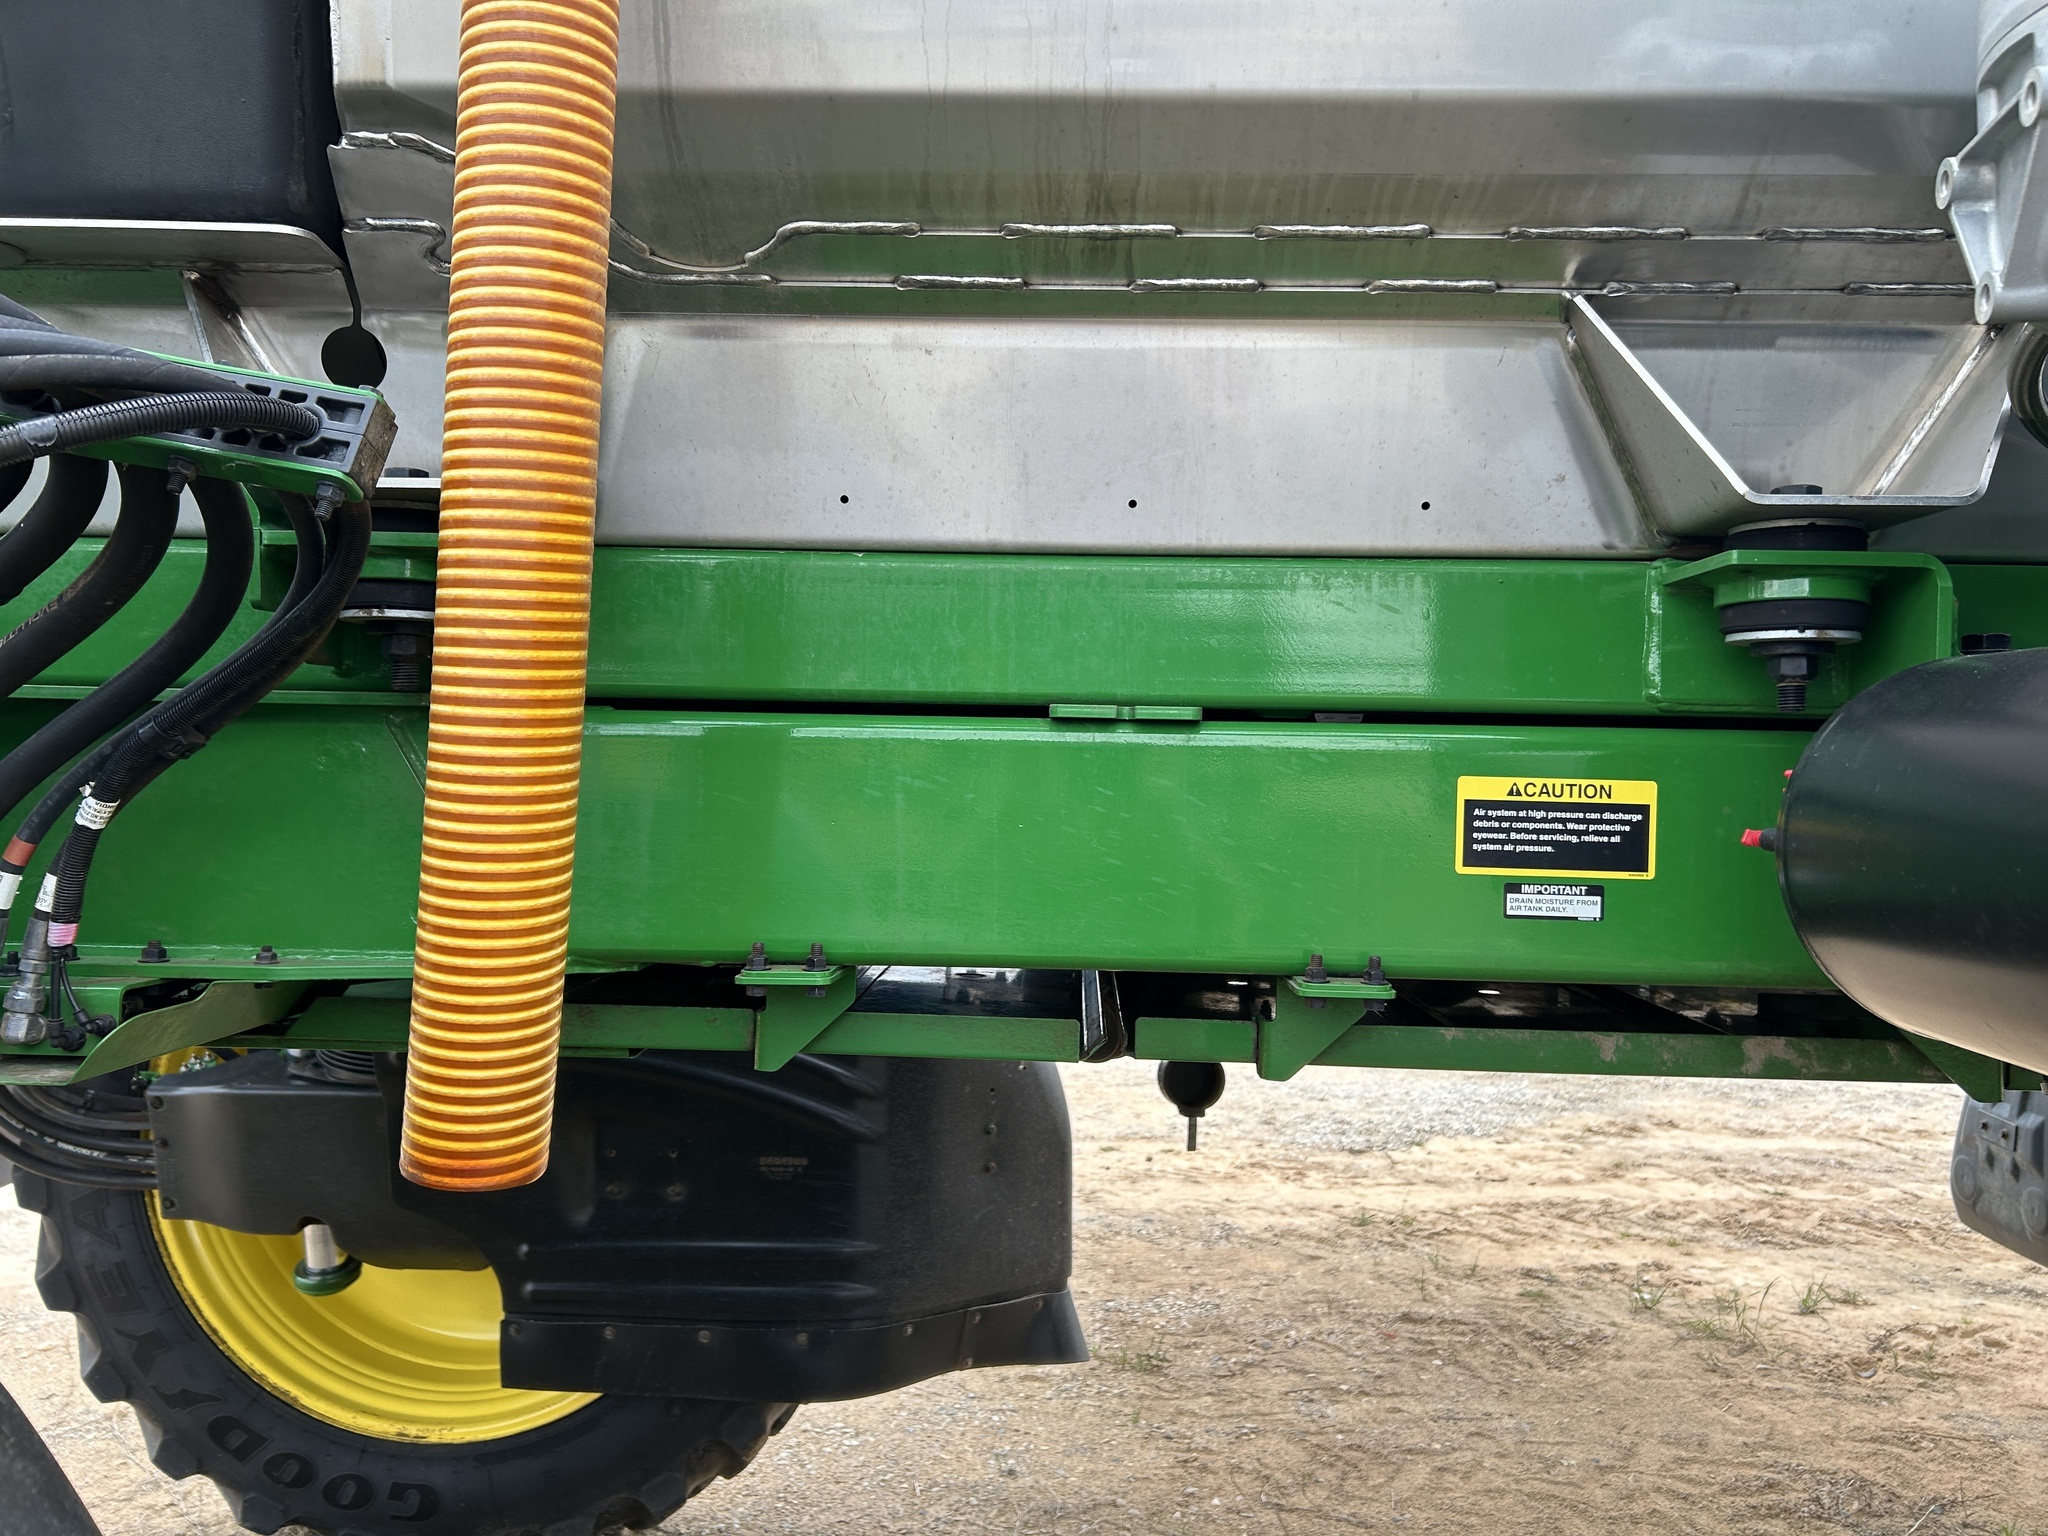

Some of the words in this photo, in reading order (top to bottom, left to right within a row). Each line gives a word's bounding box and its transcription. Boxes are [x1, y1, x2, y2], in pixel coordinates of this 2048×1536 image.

[1523, 782, 1612, 799] CAUTION
[1473, 808, 1486, 816] Air
[1487, 809, 1517, 818] system
[1528, 810, 1546, 819] high
[1547, 811, 1584, 820] pressure
[1602, 812, 1643, 822] discharge
[1473, 820, 1500, 828] debris
[1512, 821, 1565, 830] components.
[1566, 822, 1587, 830] Wear
[1589, 823, 1630, 832] protective
[1472, 832, 1508, 840] eyewear.
[1510, 832, 1537, 840] Before
[1539, 833, 1579, 843] servicing,
[1581, 834, 1608, 843] relieve
[1610, 835, 1621, 843] all
[1472, 843, 1502, 851] system
[1503, 843, 1515, 851] air
[1516, 844, 1555, 853] pressure.
[1521, 884, 1588, 896] IMPORTANT
[1535, 898, 1575, 906] MOISTURE
